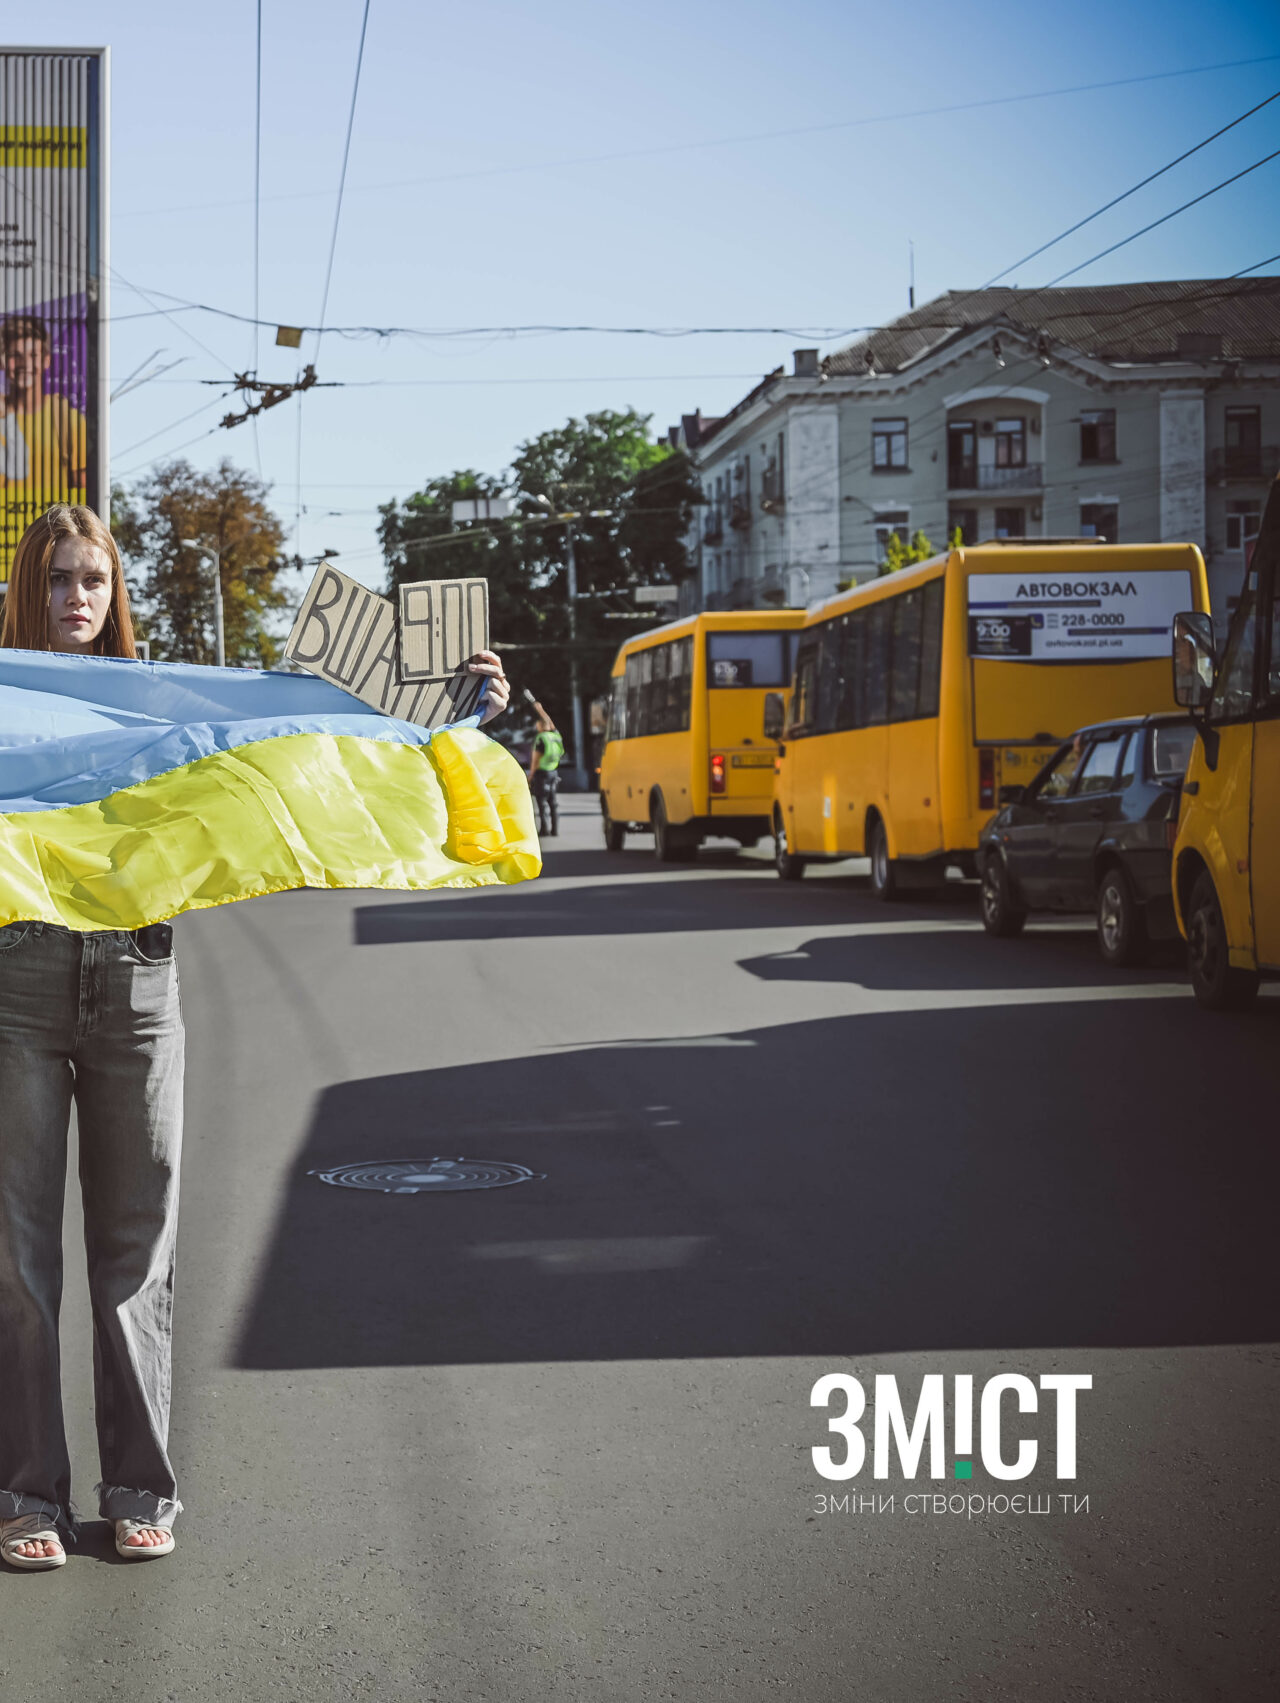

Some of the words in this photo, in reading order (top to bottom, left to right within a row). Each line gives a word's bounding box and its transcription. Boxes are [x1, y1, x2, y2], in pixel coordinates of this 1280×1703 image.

[1016, 581, 1137, 598] АВТОВОКЗАЛ
[1061, 613, 1125, 626] 228-0000
[403, 582, 488, 677] 9:00
